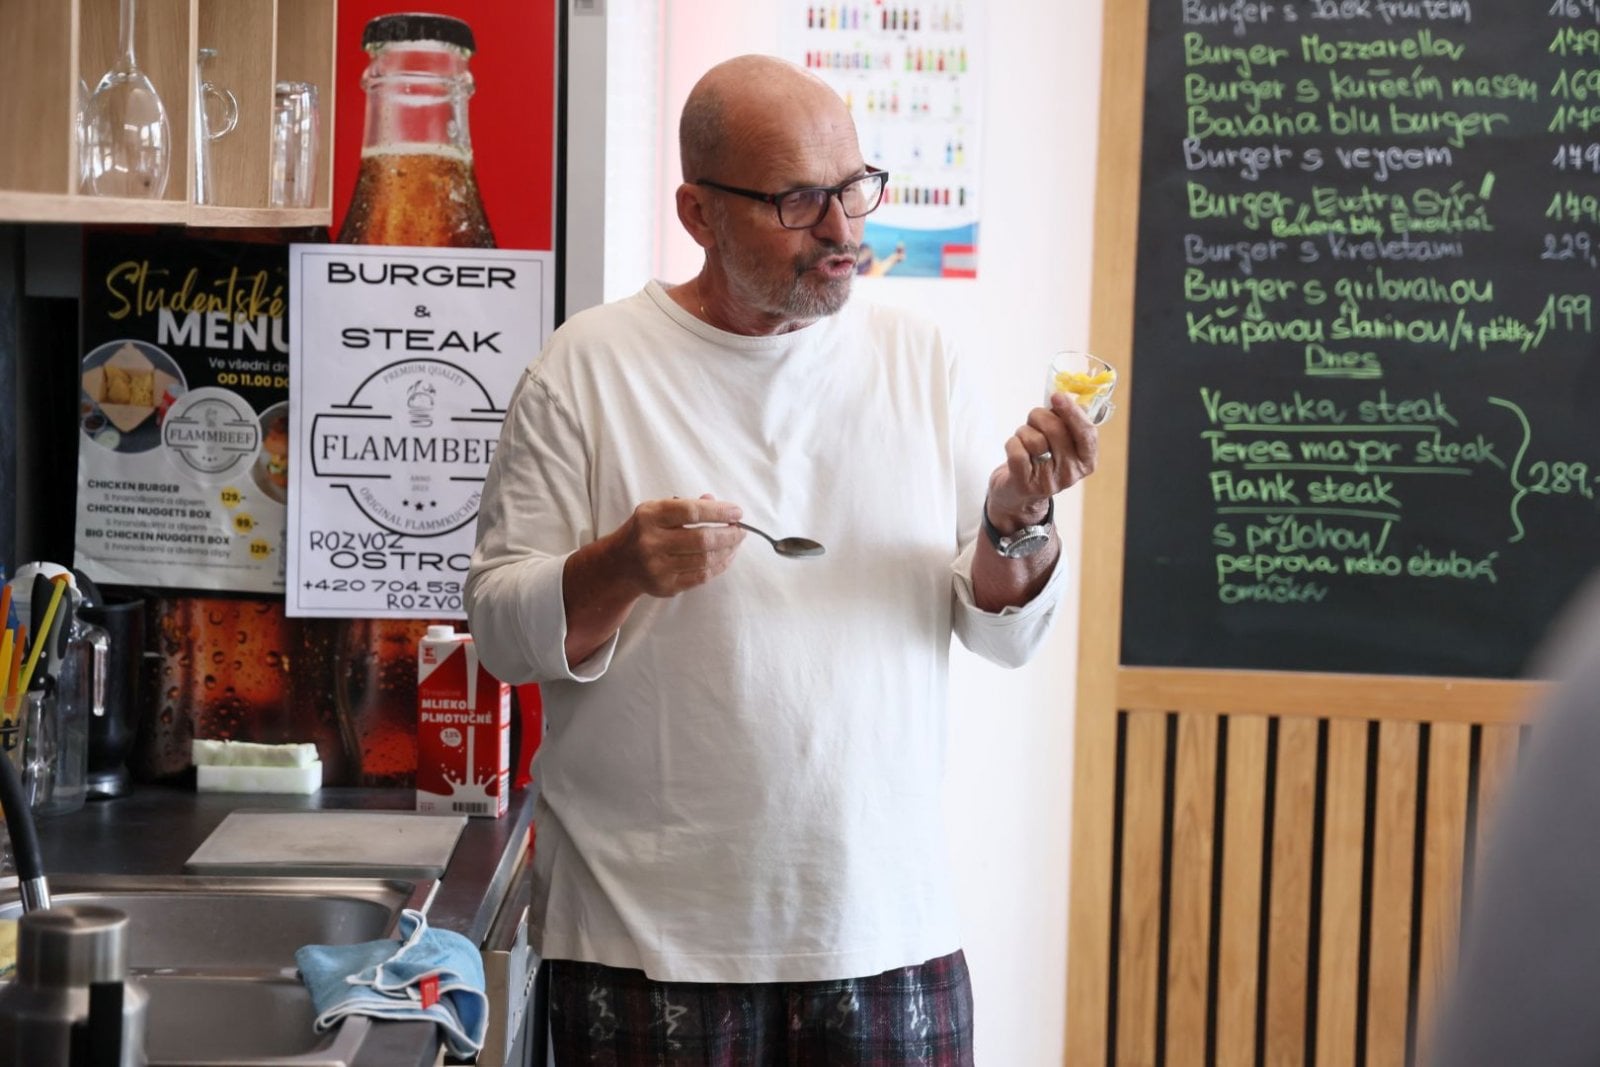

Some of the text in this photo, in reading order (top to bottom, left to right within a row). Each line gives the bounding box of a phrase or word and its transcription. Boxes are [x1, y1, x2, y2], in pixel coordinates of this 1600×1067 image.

[1183, 0, 1274, 36] Burger
[1283, 4, 1298, 22] s
[1184, 31, 1289, 79] Burger
[1301, 28, 1466, 64] Mozzarella
[1185, 72, 1285, 114] Burger
[1295, 79, 1320, 103] s
[1451, 73, 1538, 103] masem
[1327, 102, 1381, 135] blu
[1389, 102, 1510, 148] burger
[1183, 136, 1293, 181] Burger
[1301, 148, 1324, 171] s
[1335, 146, 1453, 182] vejcem
[1184, 233, 1287, 274] Burger
[1299, 241, 1321, 263] s
[327, 262, 516, 289] BURGER
[106, 260, 286, 325] Studentské
[1184, 267, 1297, 320] Burger
[1303, 279, 1328, 305] s
[414, 305, 431, 318] &
[1186, 305, 1325, 352] Křupavou
[1536, 294, 1592, 332] 199
[341, 328, 502, 353] STEAK
[208, 357, 226, 370] Ve
[228, 358, 270, 372] všední
[1305, 342, 1382, 371] Dnes
[217, 373, 238, 384] OD
[240, 374, 272, 387] 11.00
[383, 364, 467, 387] PREMIUM QUALITY
[1200, 386, 1459, 427] Veverka steak
[169, 428, 254, 444] FLAMMBEEF
[1200, 430, 1293, 463] Teres
[1300, 440, 1402, 475] major
[1414, 433, 1507, 470] steak
[87, 478, 180, 493] CHICKEN BURGER
[1208, 470, 1403, 508] Flank steak
[86, 503, 211, 519] CHICKEN NUGGETS BOX
[360, 486, 402, 527] ORIGINAL
[85, 528, 229, 545] BIG CHICKEN NUGGETS BOX
[310, 530, 403, 551] ROZVOZ
[1212, 522, 1236, 548] s
[303, 579, 365, 592] +420
[371, 579, 420, 593] 704
[427, 581, 464, 593] 53
[421, 698, 467, 710] MLIEKO
[421, 711, 492, 724] PLNOTUČNÉ
